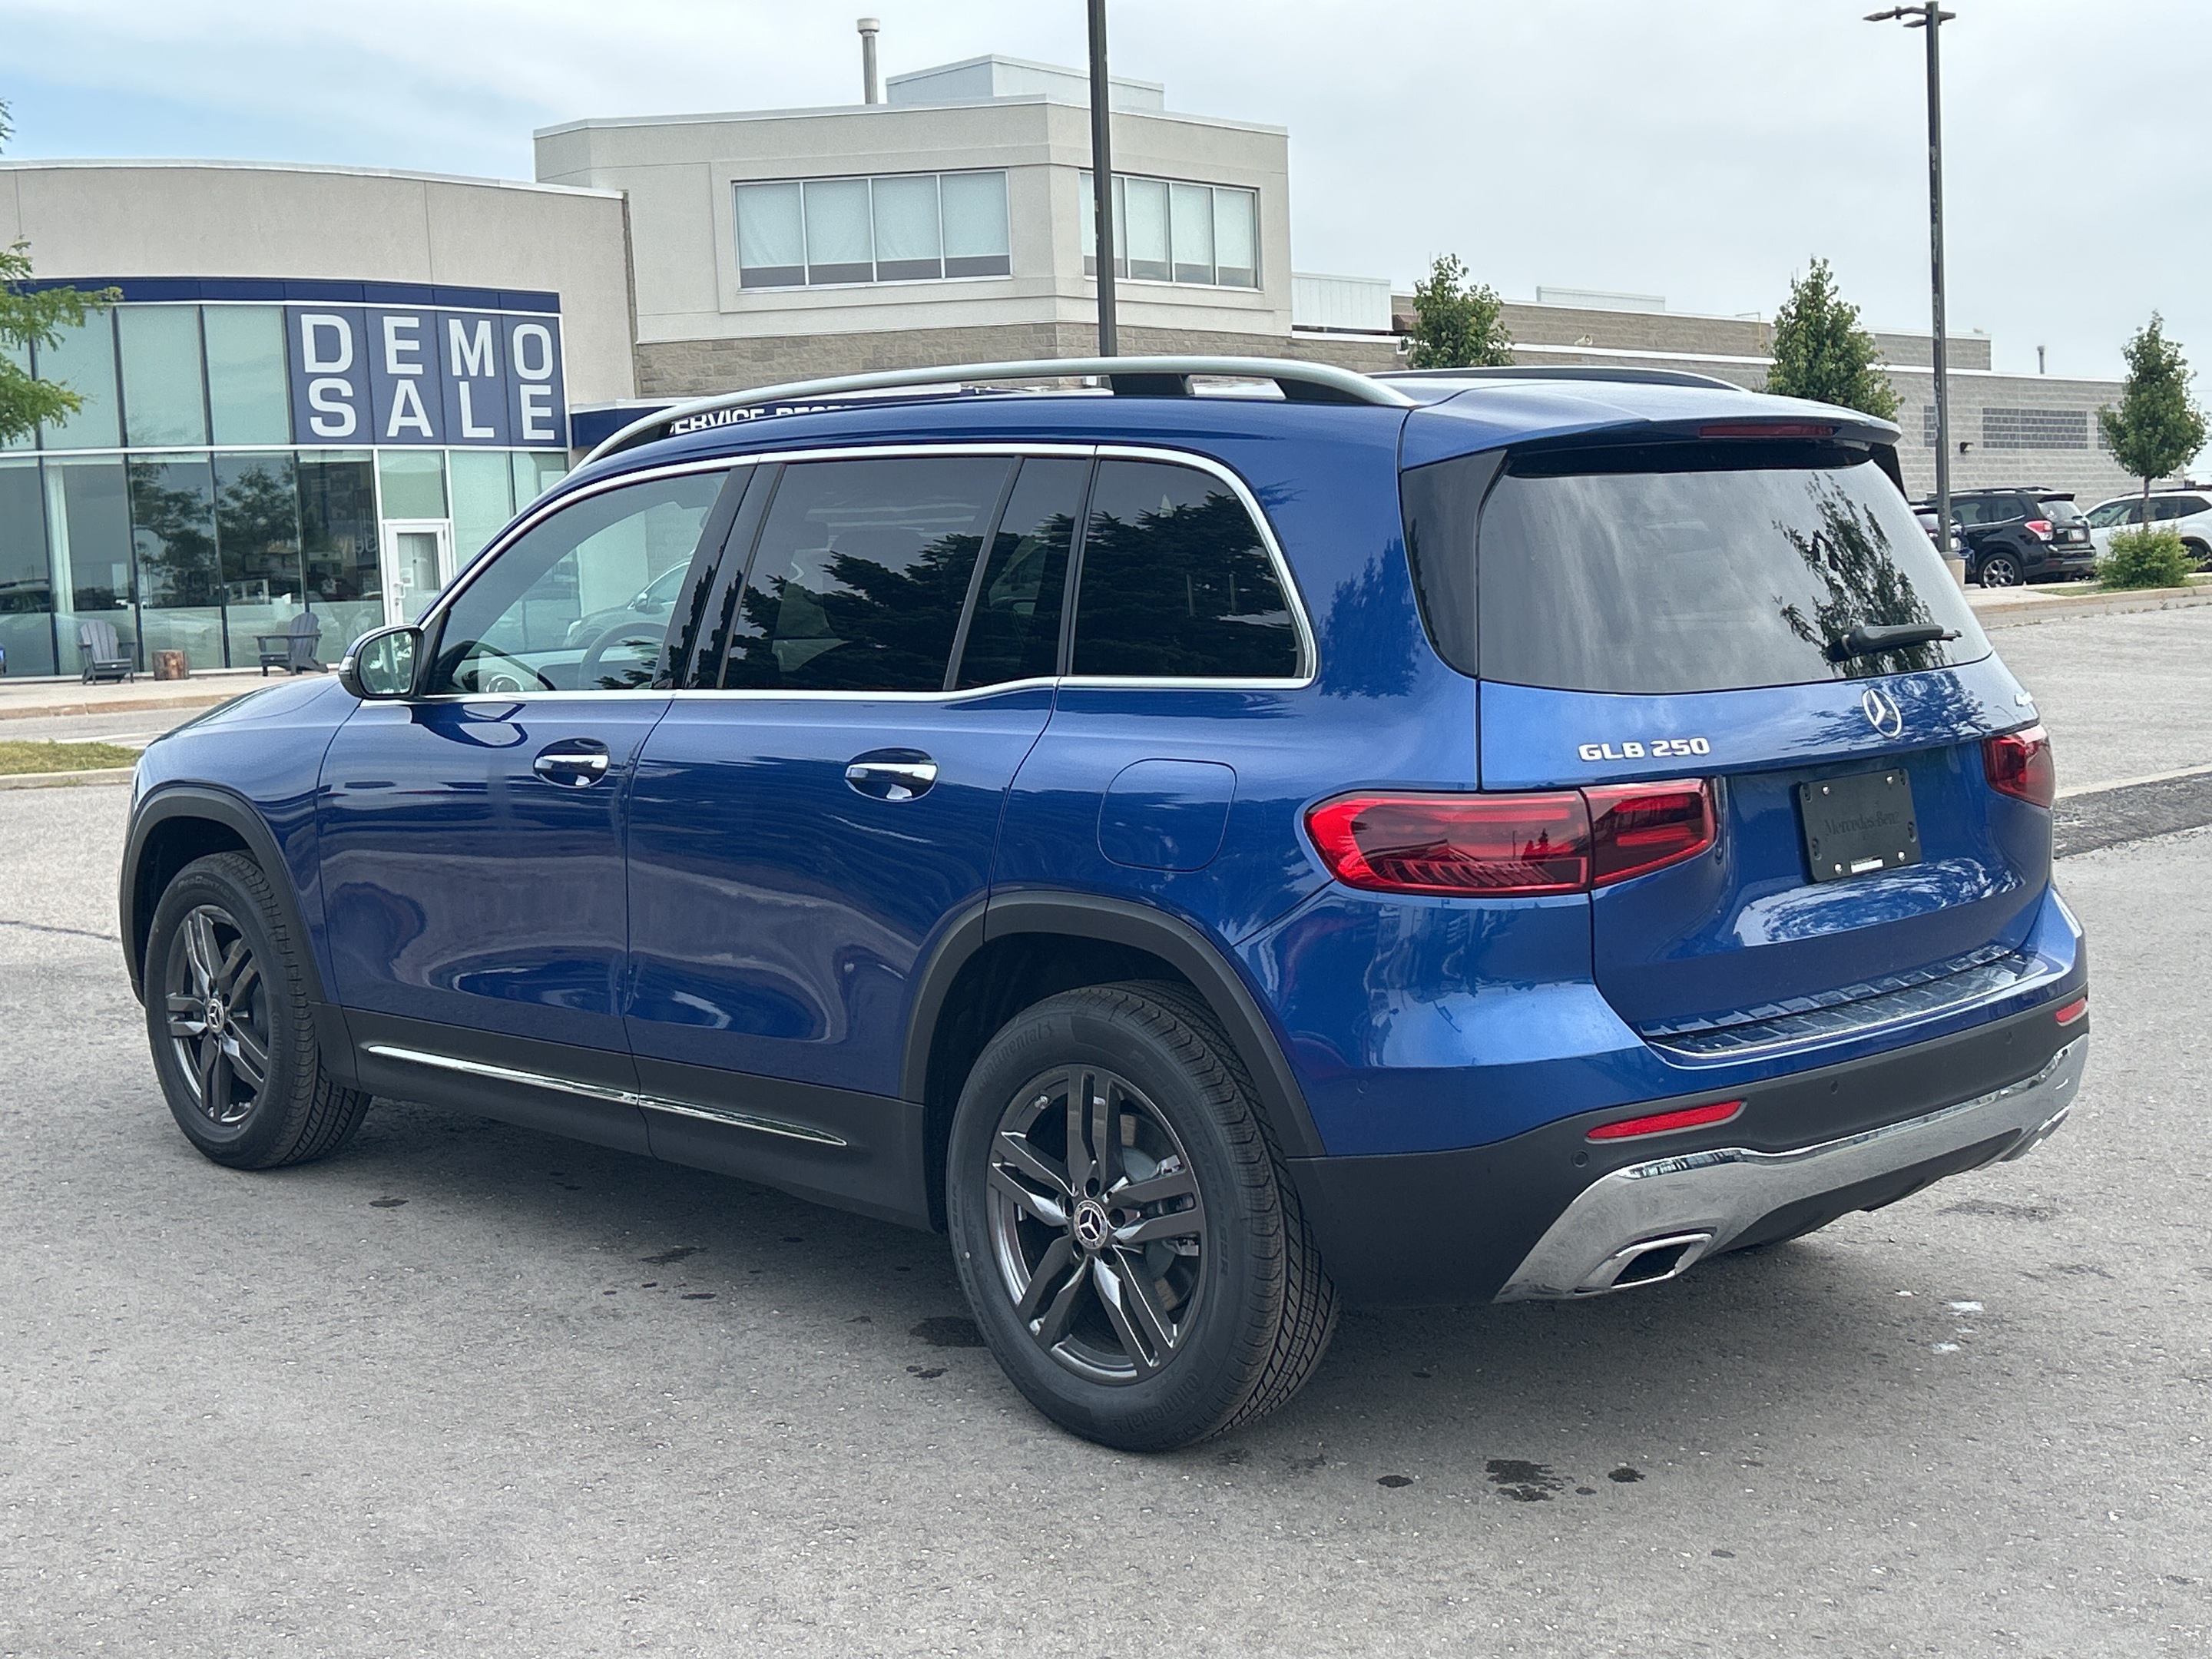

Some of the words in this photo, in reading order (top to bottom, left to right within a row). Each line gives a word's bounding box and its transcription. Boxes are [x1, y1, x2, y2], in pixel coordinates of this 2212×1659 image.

[301, 314, 553, 380] DEMO
[309, 378, 555, 441] SALE
[670, 408, 765, 435] ERVICE
[1578, 741, 1645, 761] GLB
[1650, 737, 1710, 757] 250
